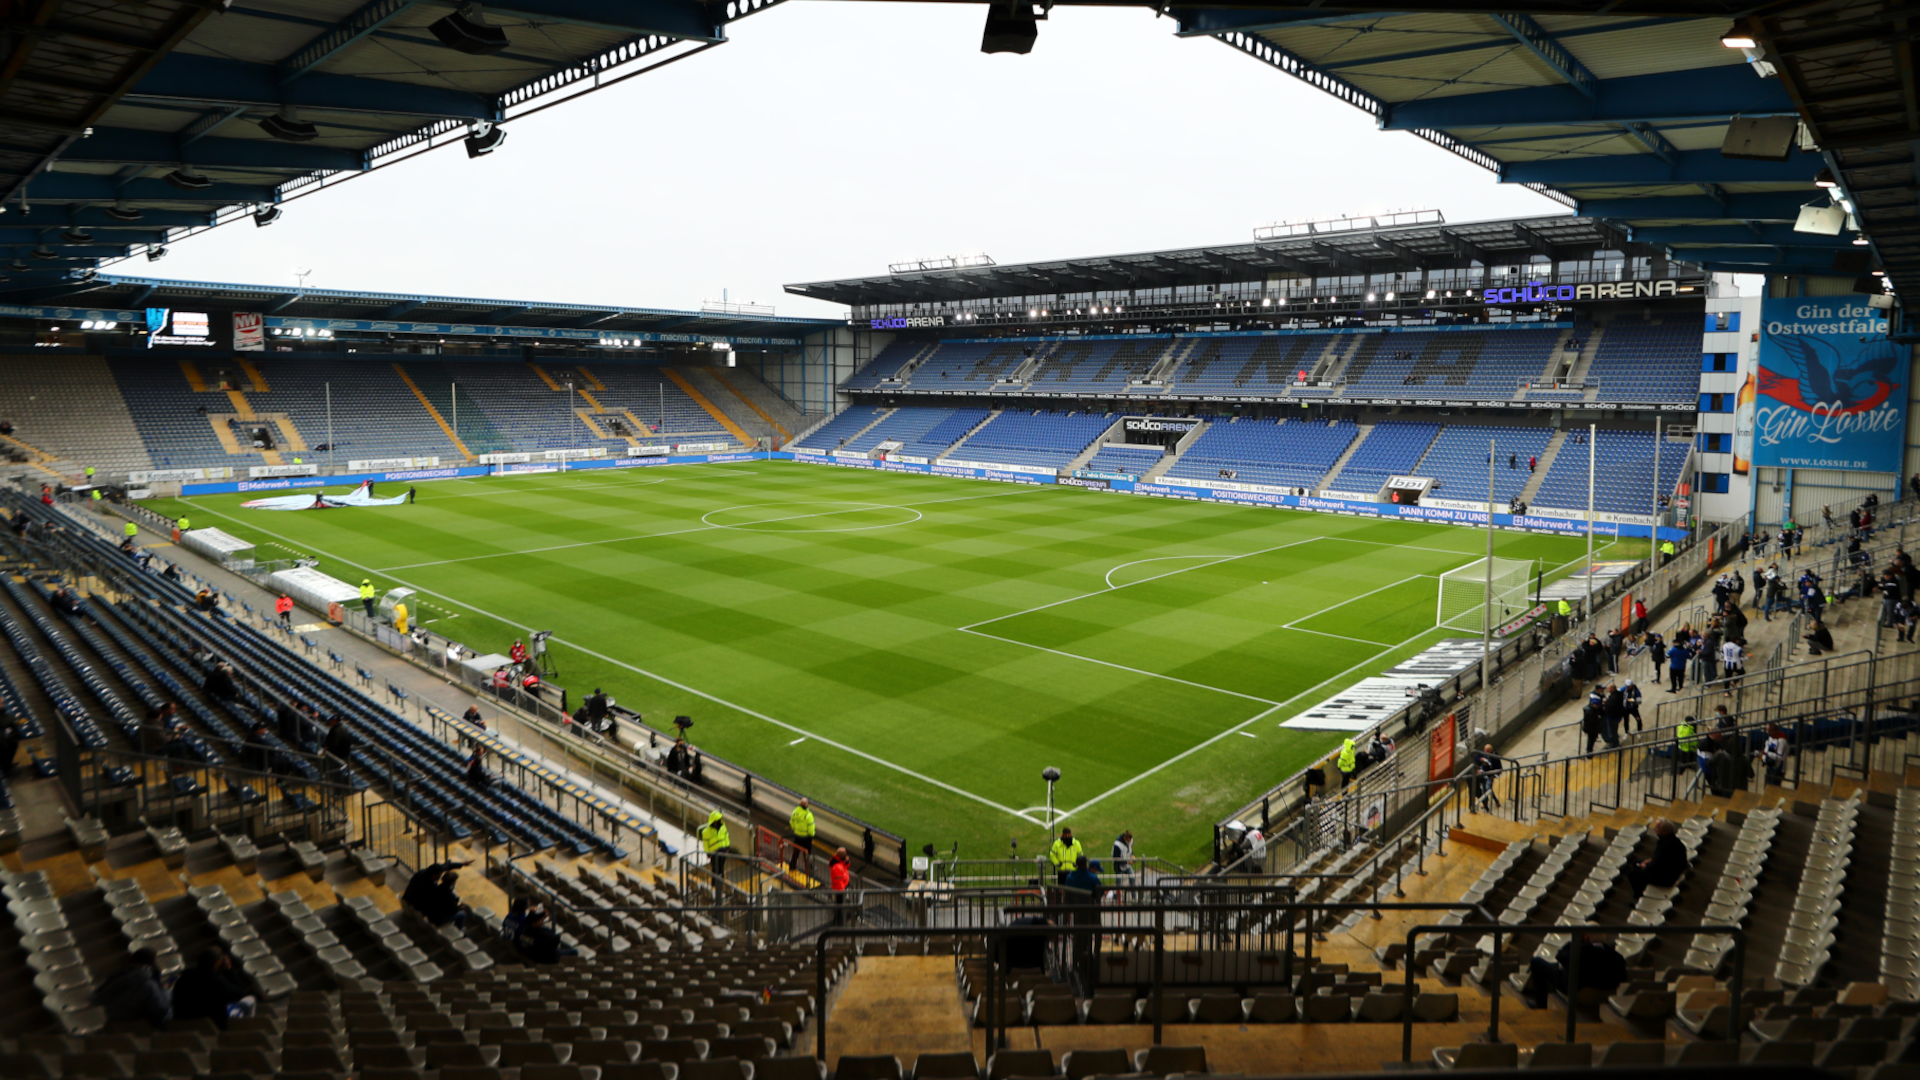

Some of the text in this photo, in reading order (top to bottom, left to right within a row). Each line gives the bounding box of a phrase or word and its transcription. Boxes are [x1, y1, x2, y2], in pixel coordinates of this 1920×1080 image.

[1796, 304, 1874, 319] Gin der
[235, 314, 257, 329] NW
[1767, 319, 1888, 335] Ostwestfale
[1756, 400, 1900, 446] Gin Lossie
[1780, 457, 1868, 468] WWW.LOSSIE.DE
[148, 470, 196, 482] Krombacher
[268, 466, 311, 476] Krombacher
[385, 469, 459, 480] POSITIONSWECHSEL?
[250, 480, 290, 489] Mehrwerk
[1210, 481, 1237, 489] Krombacher
[1394, 479, 1422, 487] bpi
[1141, 484, 1170, 493] Mehrwerk
[1261, 486, 1289, 494] Krombacher
[1212, 490, 1284, 503] POSITIONSWECHSEL?
[1328, 491, 1359, 500] Krombacher
[1308, 500, 1345, 509] Mehrwerk
[1441, 501, 1477, 510] Krombacher
[1399, 507, 1489, 522] DANN KOMM ZU UNS!
[1536, 508, 1576, 518] Krombacher
[1525, 516, 1573, 530] Mehrwerk
